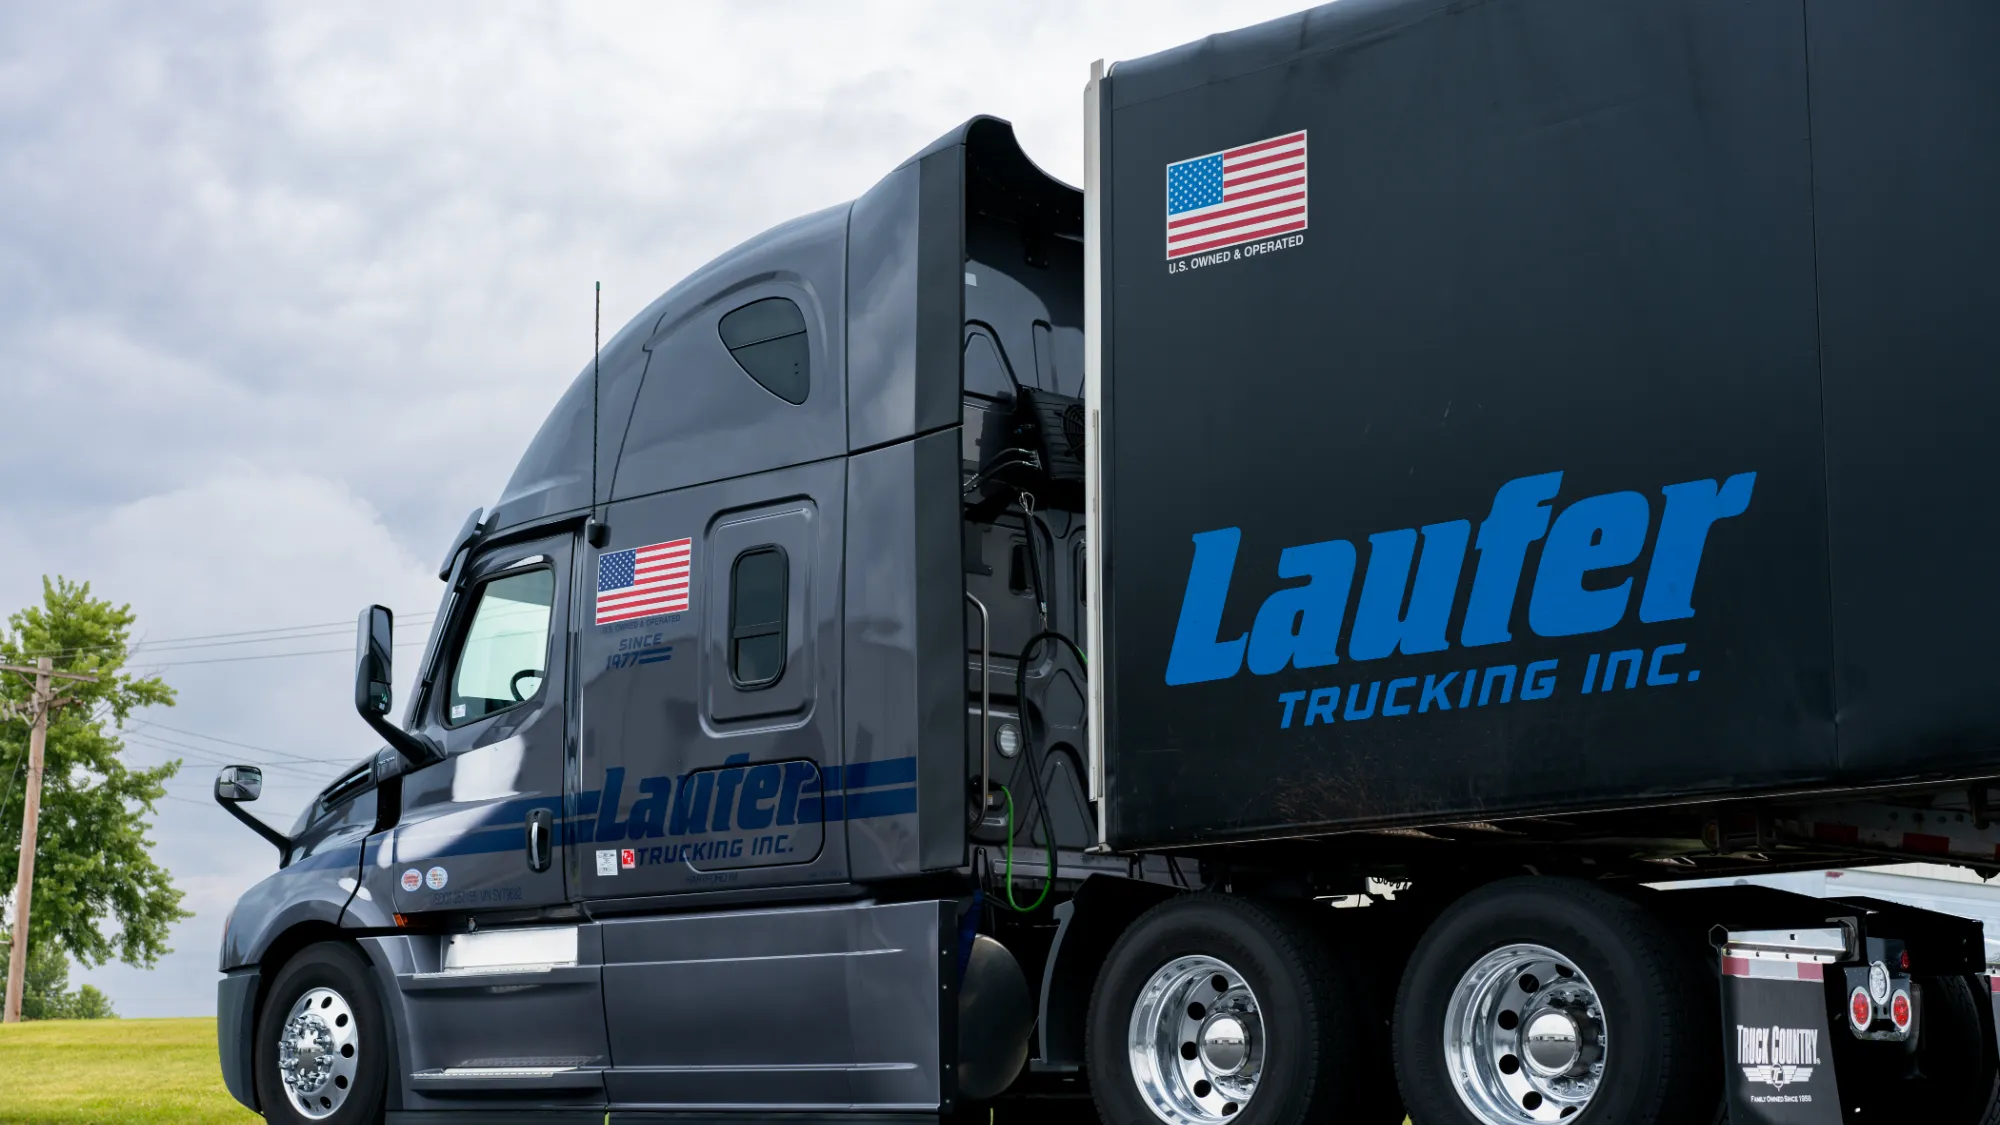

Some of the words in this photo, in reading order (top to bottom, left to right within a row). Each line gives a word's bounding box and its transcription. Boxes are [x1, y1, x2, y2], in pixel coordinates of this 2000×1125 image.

[1168, 260, 1189, 275] U.S.
[1190, 251, 1231, 269] OWNED
[1233, 248, 1242, 260] &
[1243, 234, 1304, 258] OPERATED
[1164, 470, 1758, 687] Laufer
[615, 621, 638, 632] OWNED
[646, 614, 680, 626] OPERATED
[618, 633, 663, 651] SINCE
[605, 651, 640, 671] 1977
[1277, 663, 1560, 730] TRUCKING
[1580, 643, 1701, 695] INC.
[595, 753, 818, 843] Laufer
[637, 838, 743, 867] TRUCKING
[751, 834, 794, 856] INC.
[1736, 1024, 1770, 1065] TRUCK
[1771, 1025, 1818, 1065] COUNTRY
[1750, 1095, 1767, 1103] FAMILY
[1767, 1095, 1784, 1103] OWNED
[1784, 1095, 1799, 1103] SINCE
